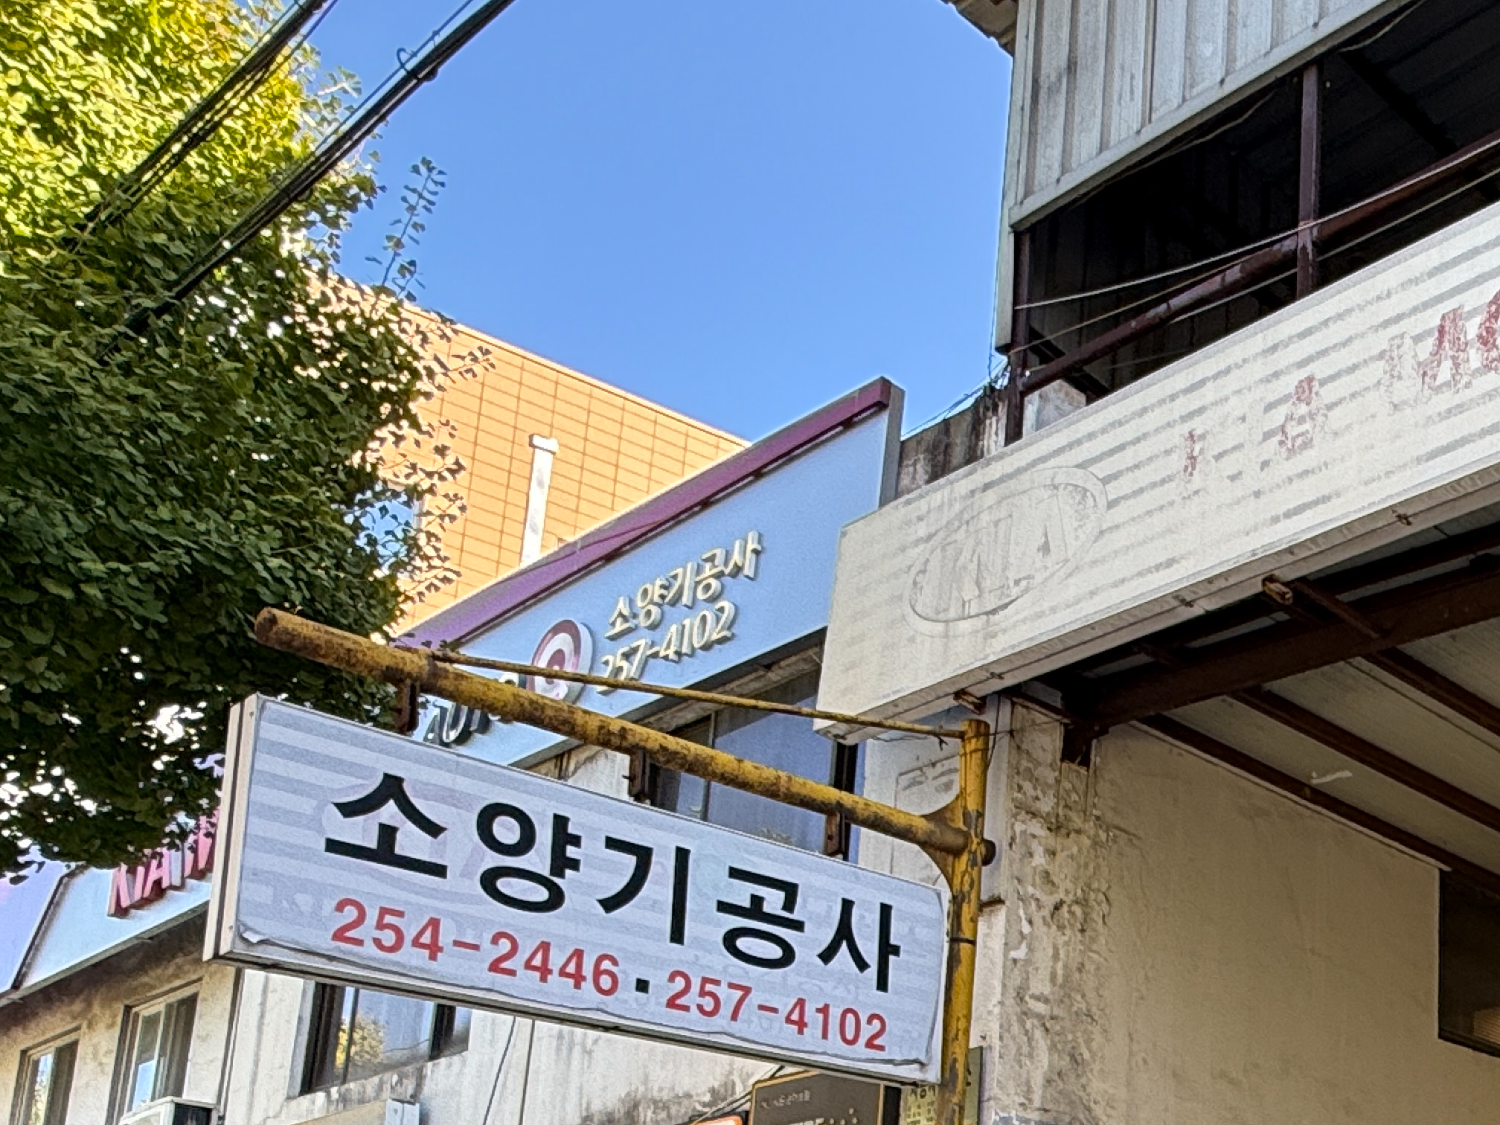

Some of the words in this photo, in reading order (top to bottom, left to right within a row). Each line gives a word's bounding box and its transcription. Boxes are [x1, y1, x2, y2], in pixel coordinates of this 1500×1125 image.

[603, 530, 763, 640] 소양기공사
[598, 601, 737, 694] 257-4102
[324, 772, 901, 993] 소양기공사
